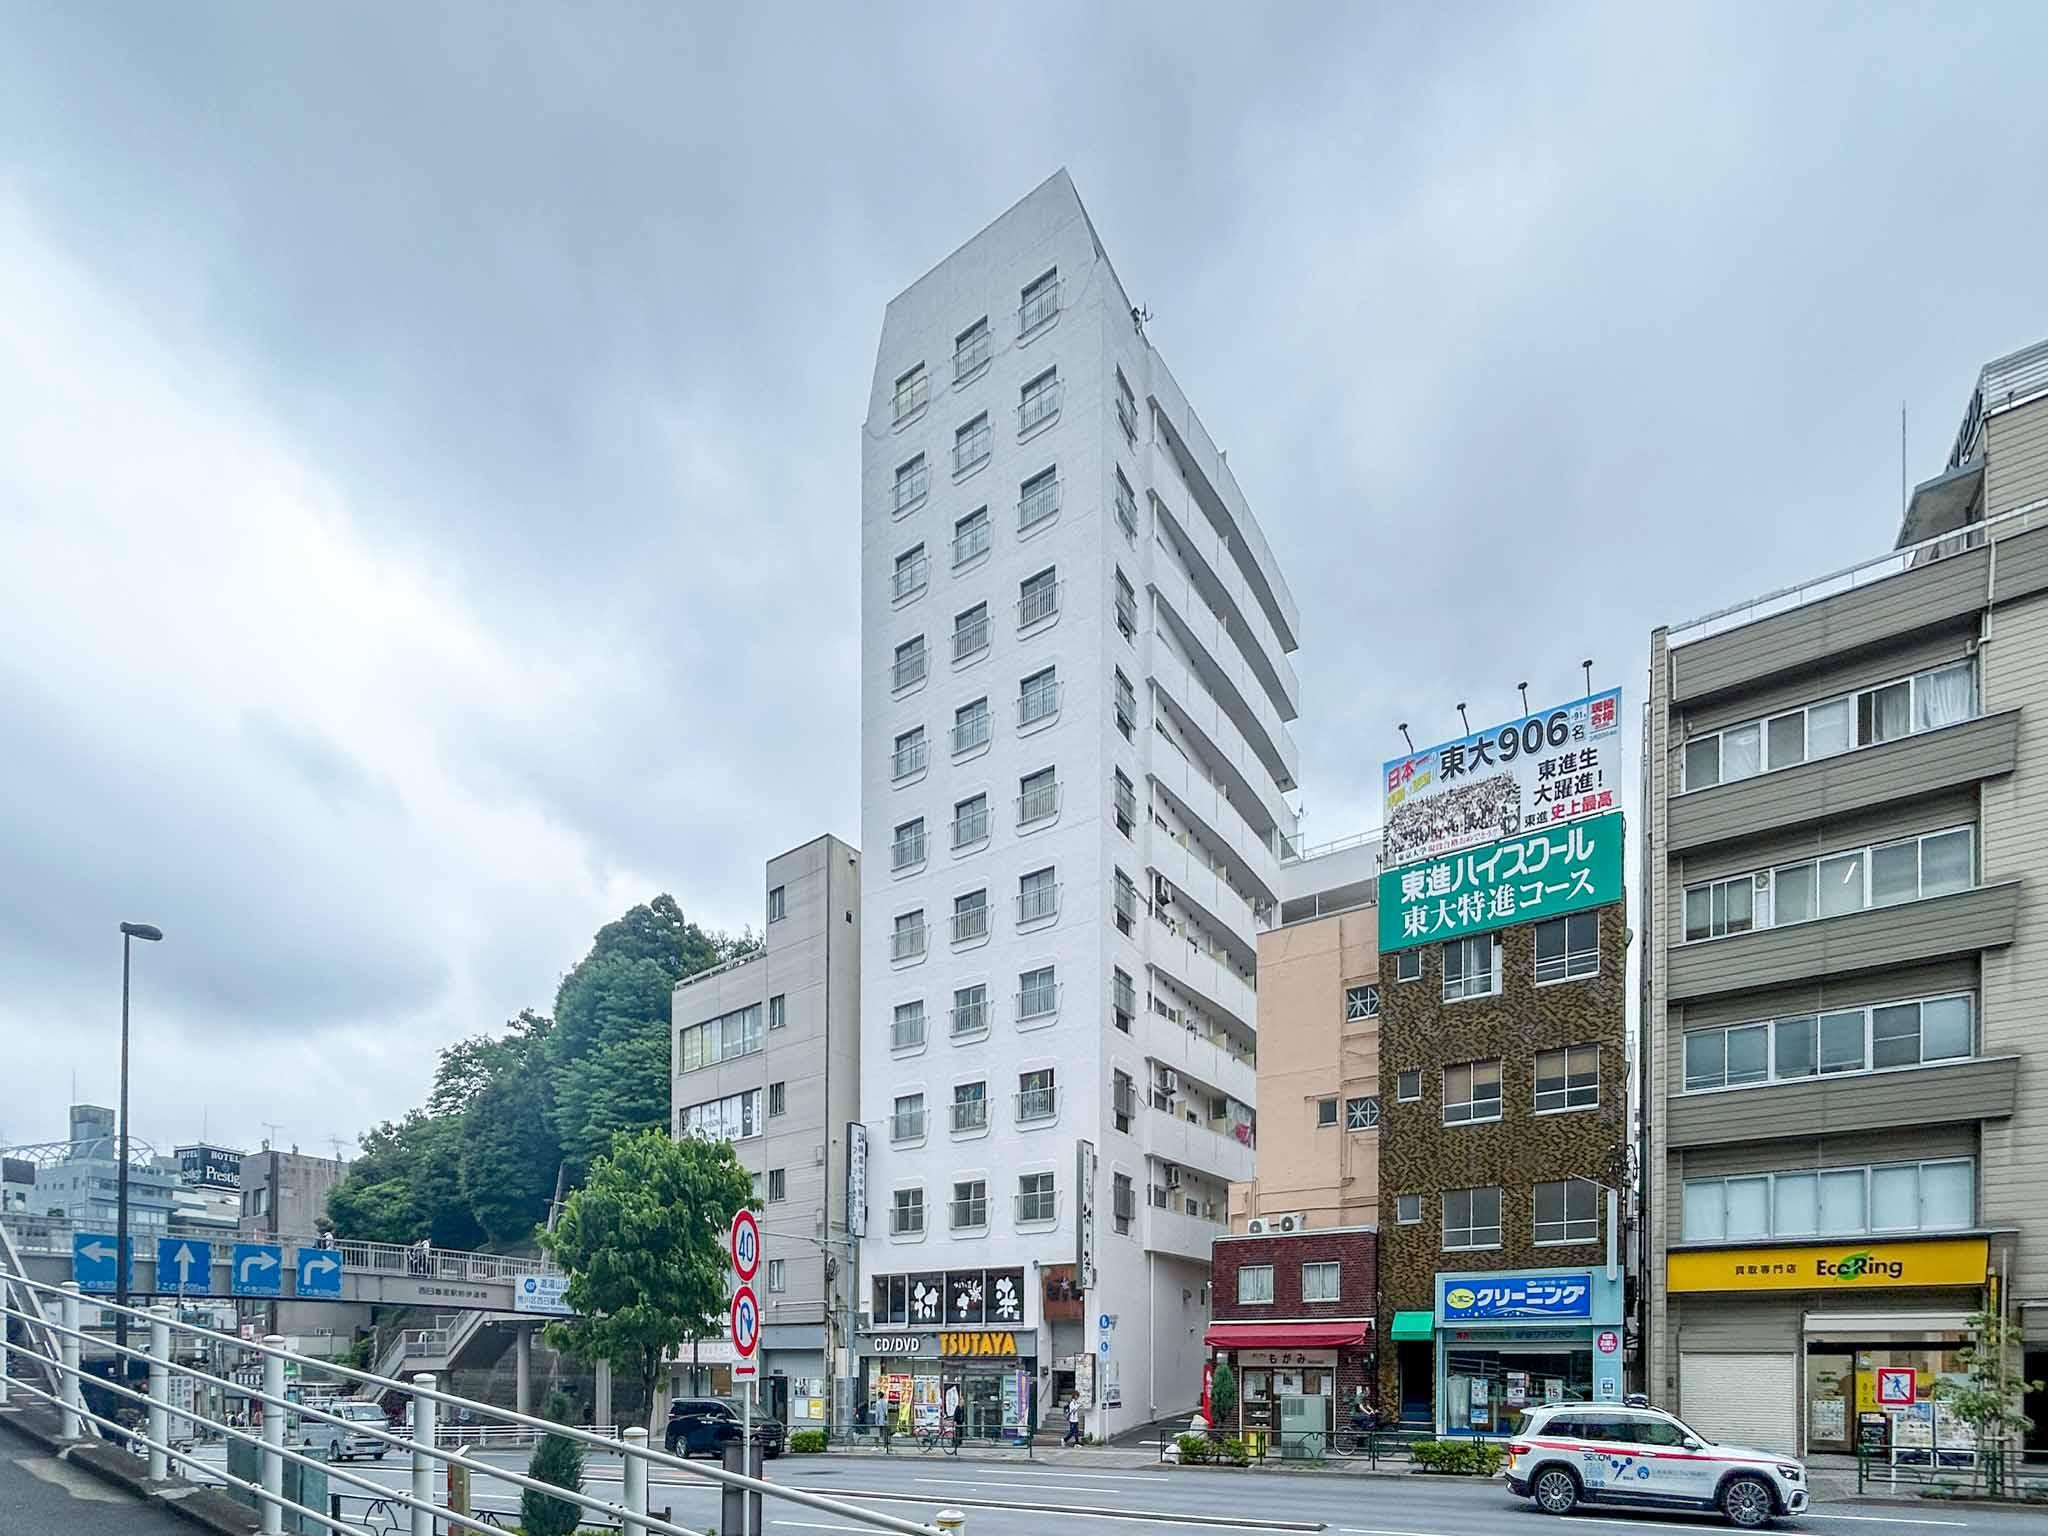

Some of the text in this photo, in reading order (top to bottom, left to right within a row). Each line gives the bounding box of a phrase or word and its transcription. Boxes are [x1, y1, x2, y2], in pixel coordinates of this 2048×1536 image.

[1537, 747, 1598, 781] 東進生
[1401, 826, 1595, 904] 東進ハイスクール
[1401, 867, 1595, 938] 東大特進コース
[210, 1150, 240, 1163] HOTEL
[738, 1231, 754, 1262] 40
[1735, 1264, 1797, 1276] 買取専門店
[1476, 1285, 1586, 1306] クリーニング
[874, 1337, 920, 1352] CD/DVD
[939, 1332, 1017, 1355] TSUTAYA
[1269, 1353, 1306, 1364] もがみ
